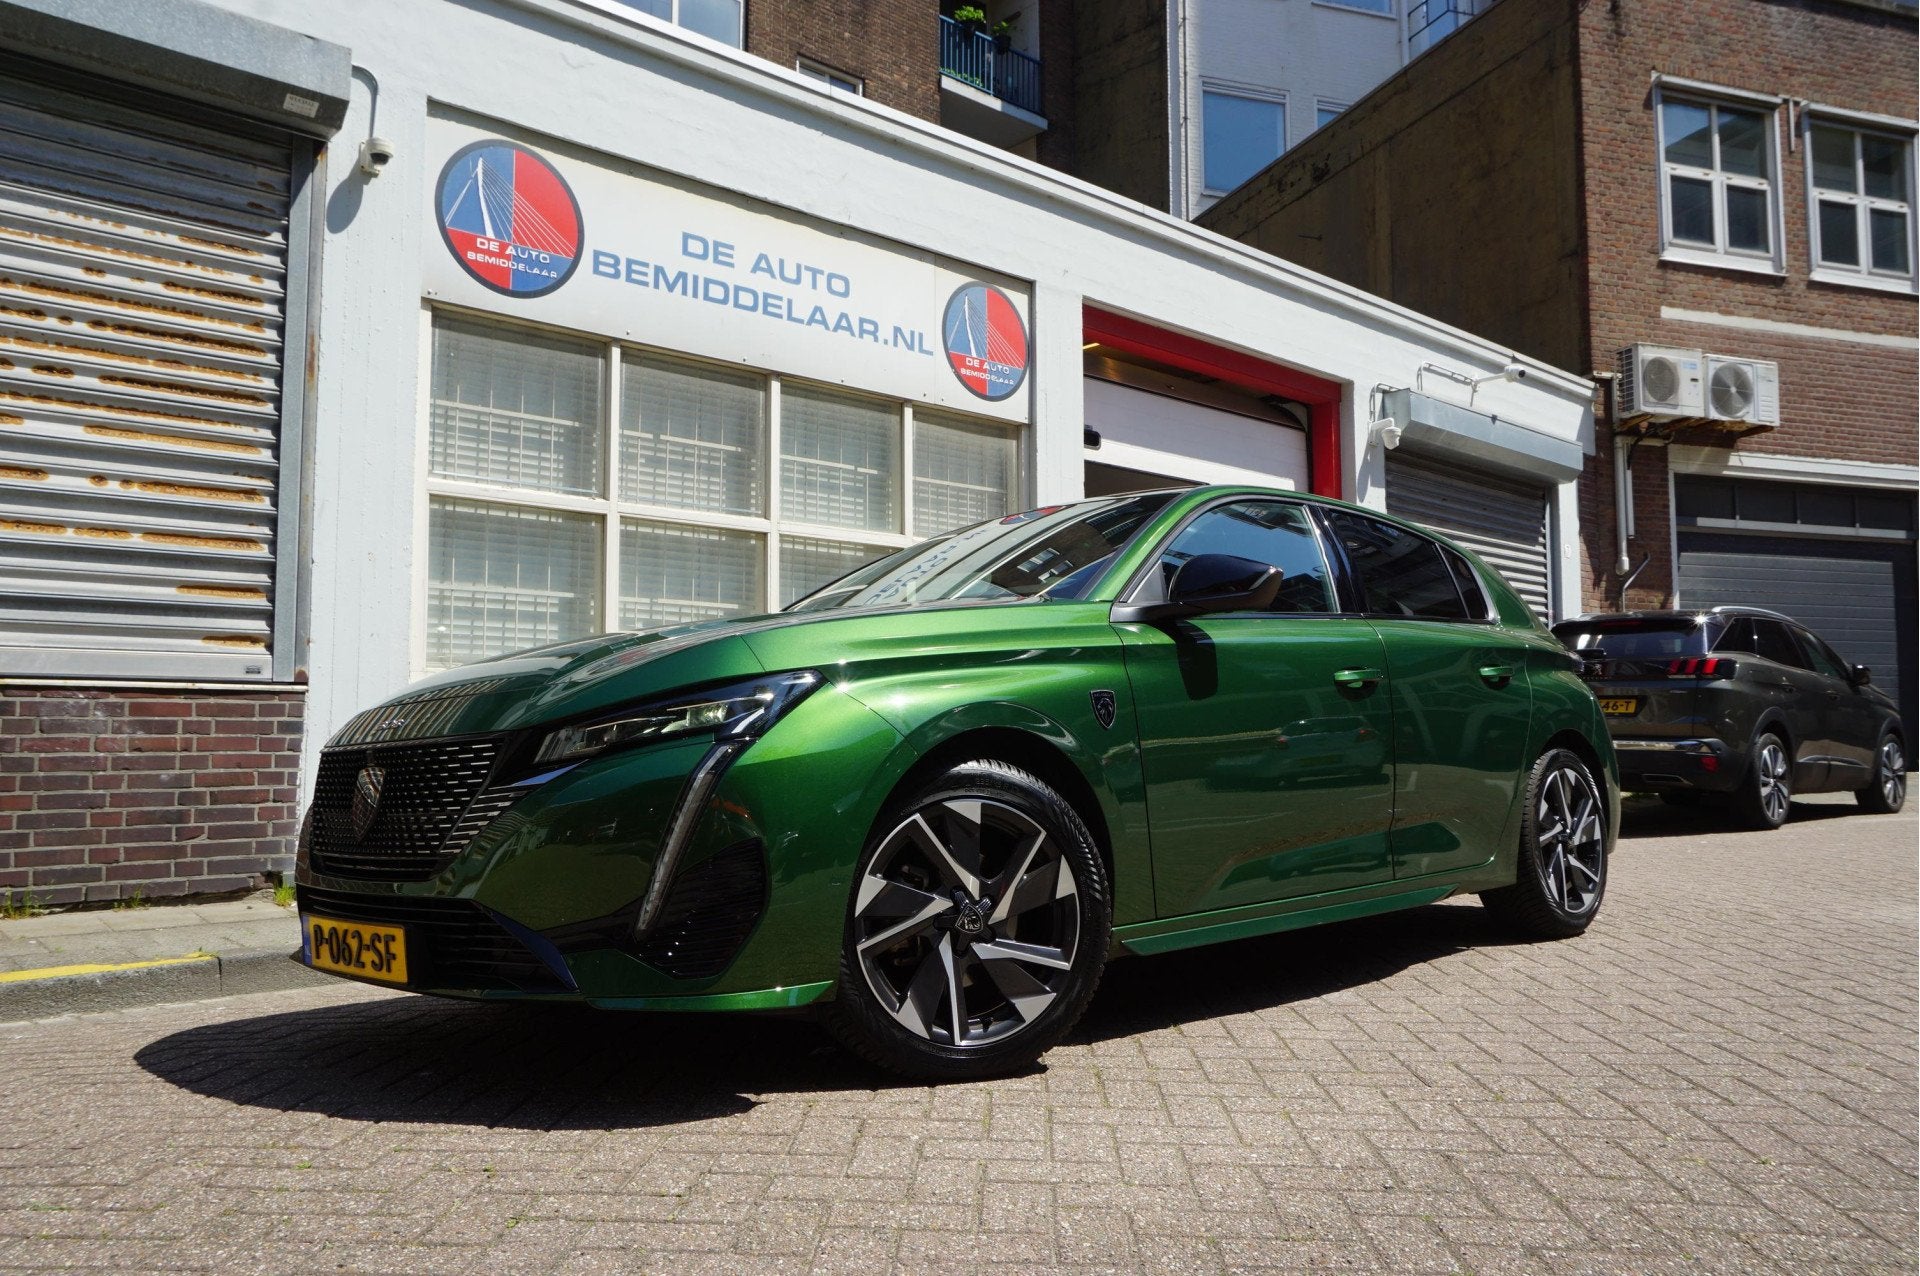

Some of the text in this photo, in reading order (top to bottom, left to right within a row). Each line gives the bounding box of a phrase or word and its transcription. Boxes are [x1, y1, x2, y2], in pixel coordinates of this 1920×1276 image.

[467, 251, 558, 278] BEMIDDELAAR
[476, 237, 550, 263] DE AUTO
[681, 231, 850, 298] DE AUTO
[592, 249, 934, 356] BEMIDDELAAR.NL
[965, 357, 1010, 374] DE AUTO
[313, 924, 397, 973] P-062-SF
